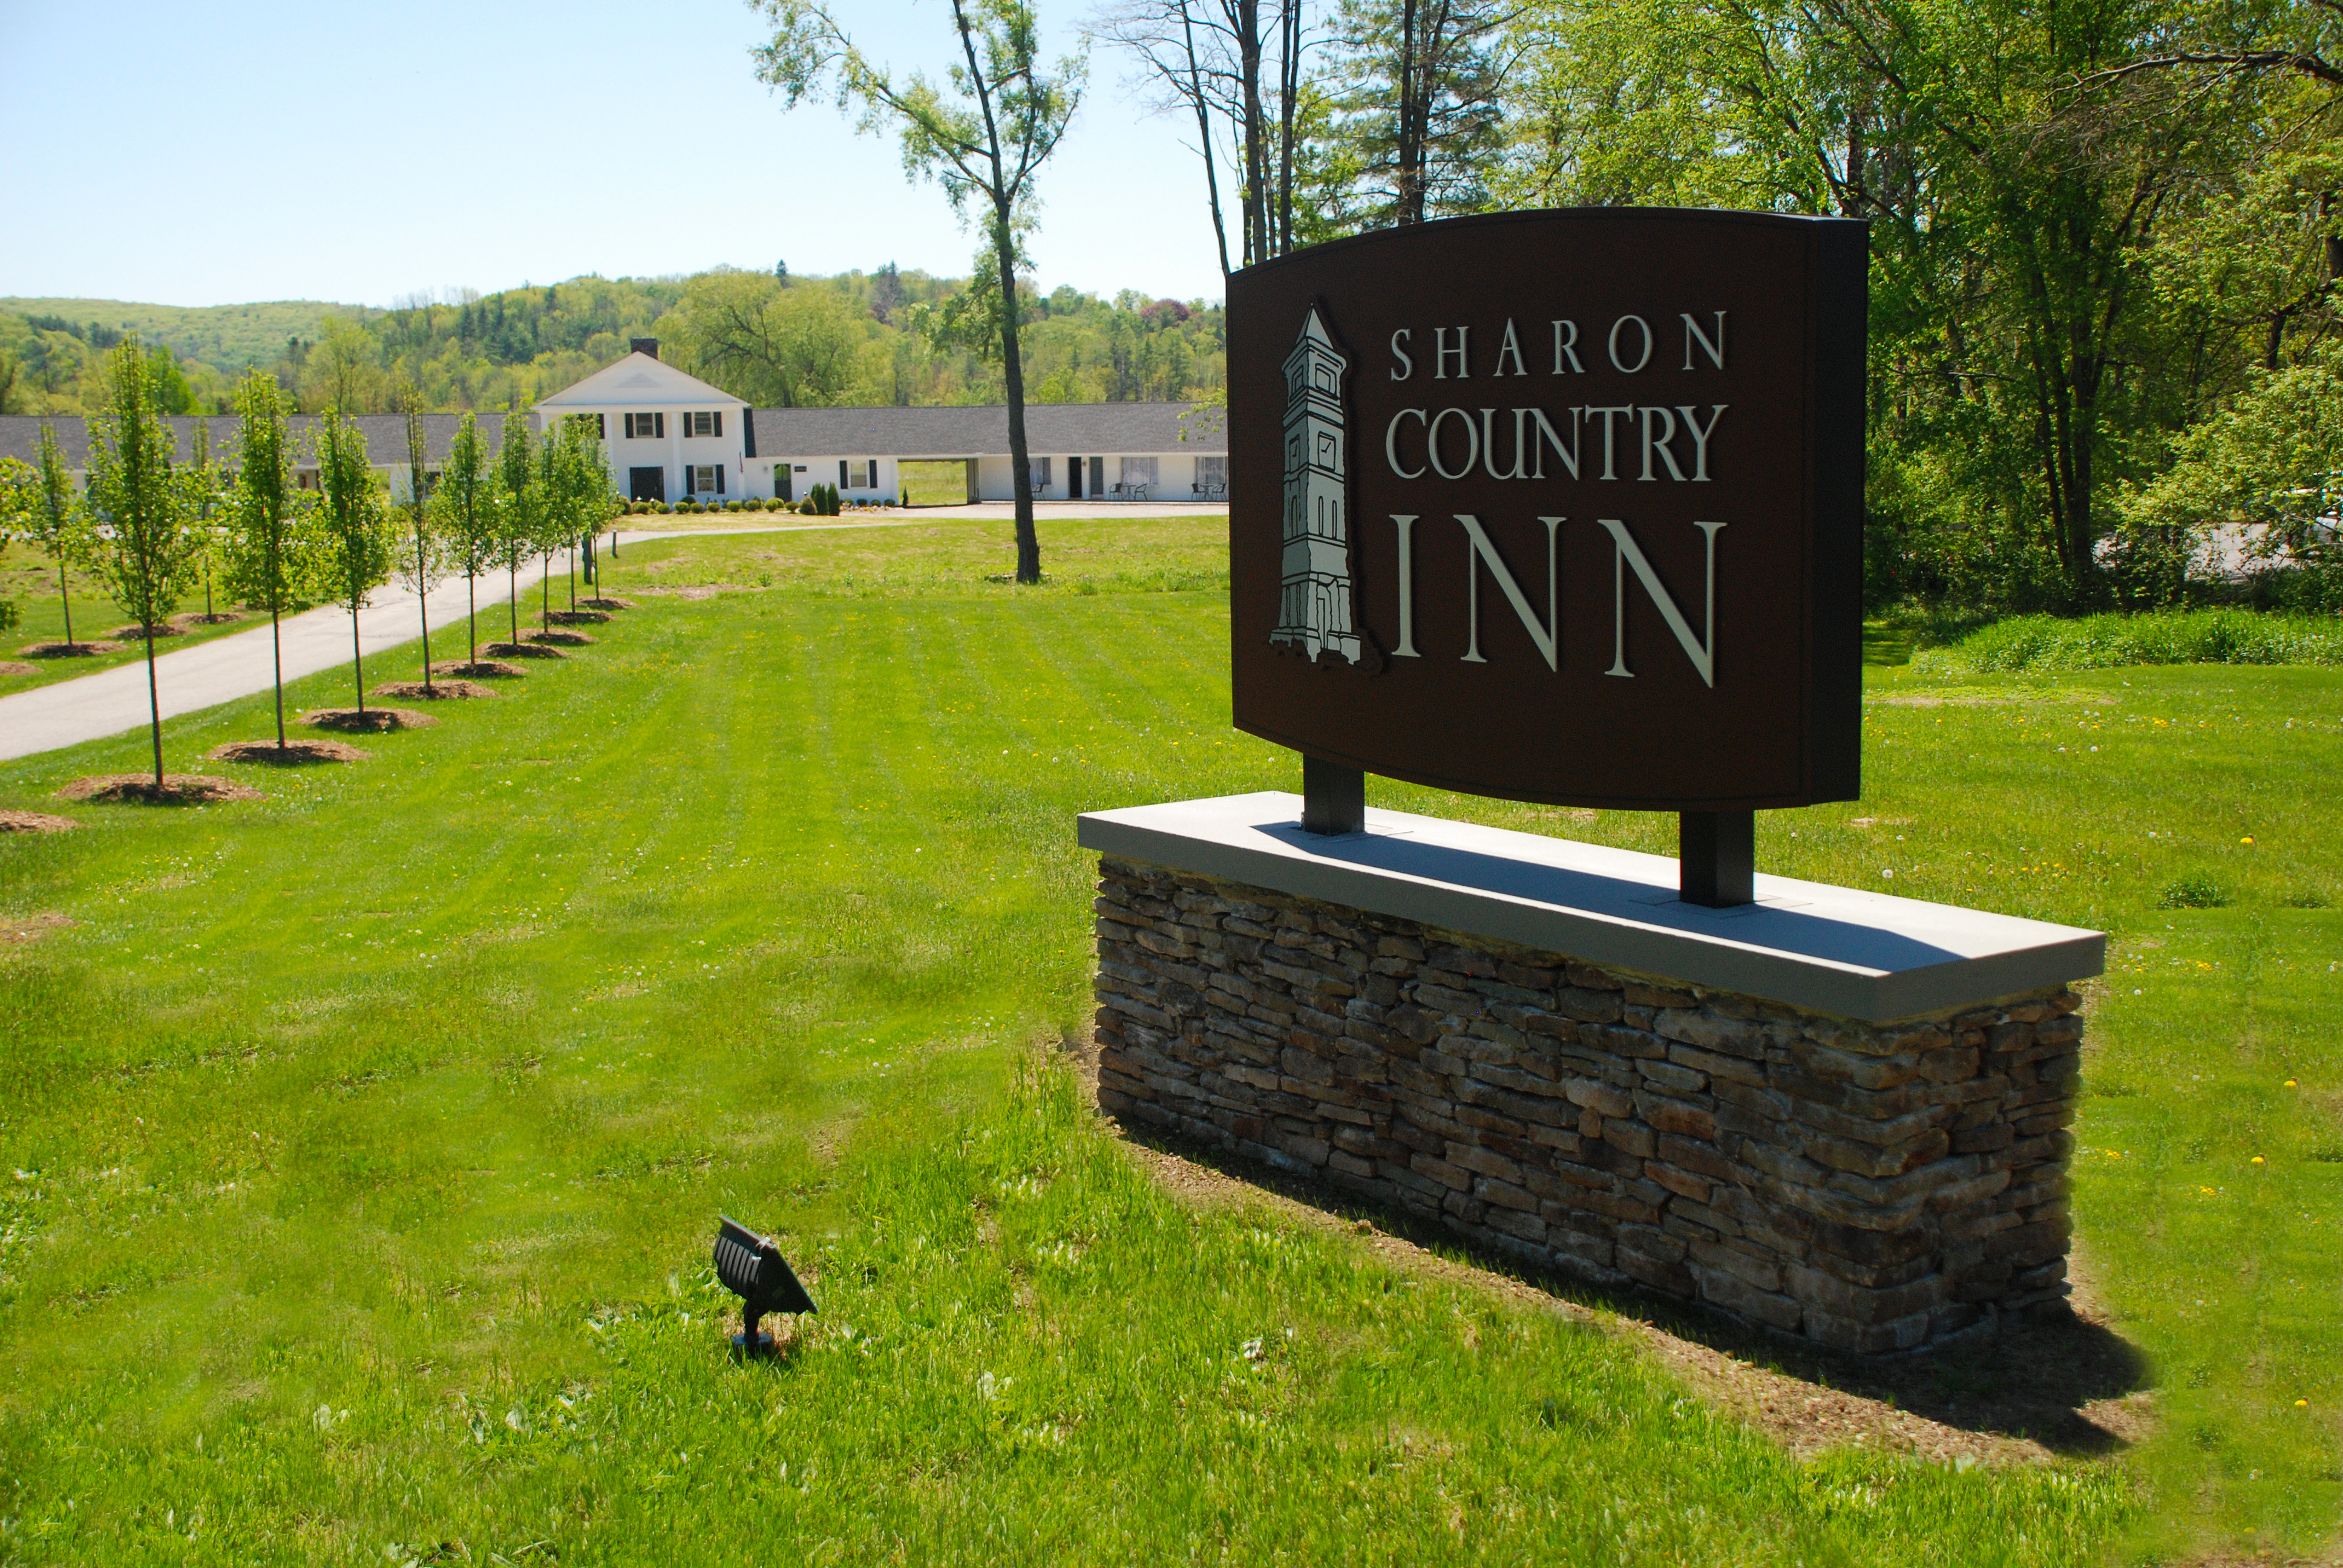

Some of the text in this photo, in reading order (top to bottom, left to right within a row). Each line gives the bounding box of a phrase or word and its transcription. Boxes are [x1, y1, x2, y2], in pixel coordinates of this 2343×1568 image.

[1391, 310, 1727, 381] SHARON
[1386, 403, 1729, 482] COUNTRY
[1389, 514, 1728, 688] INN
